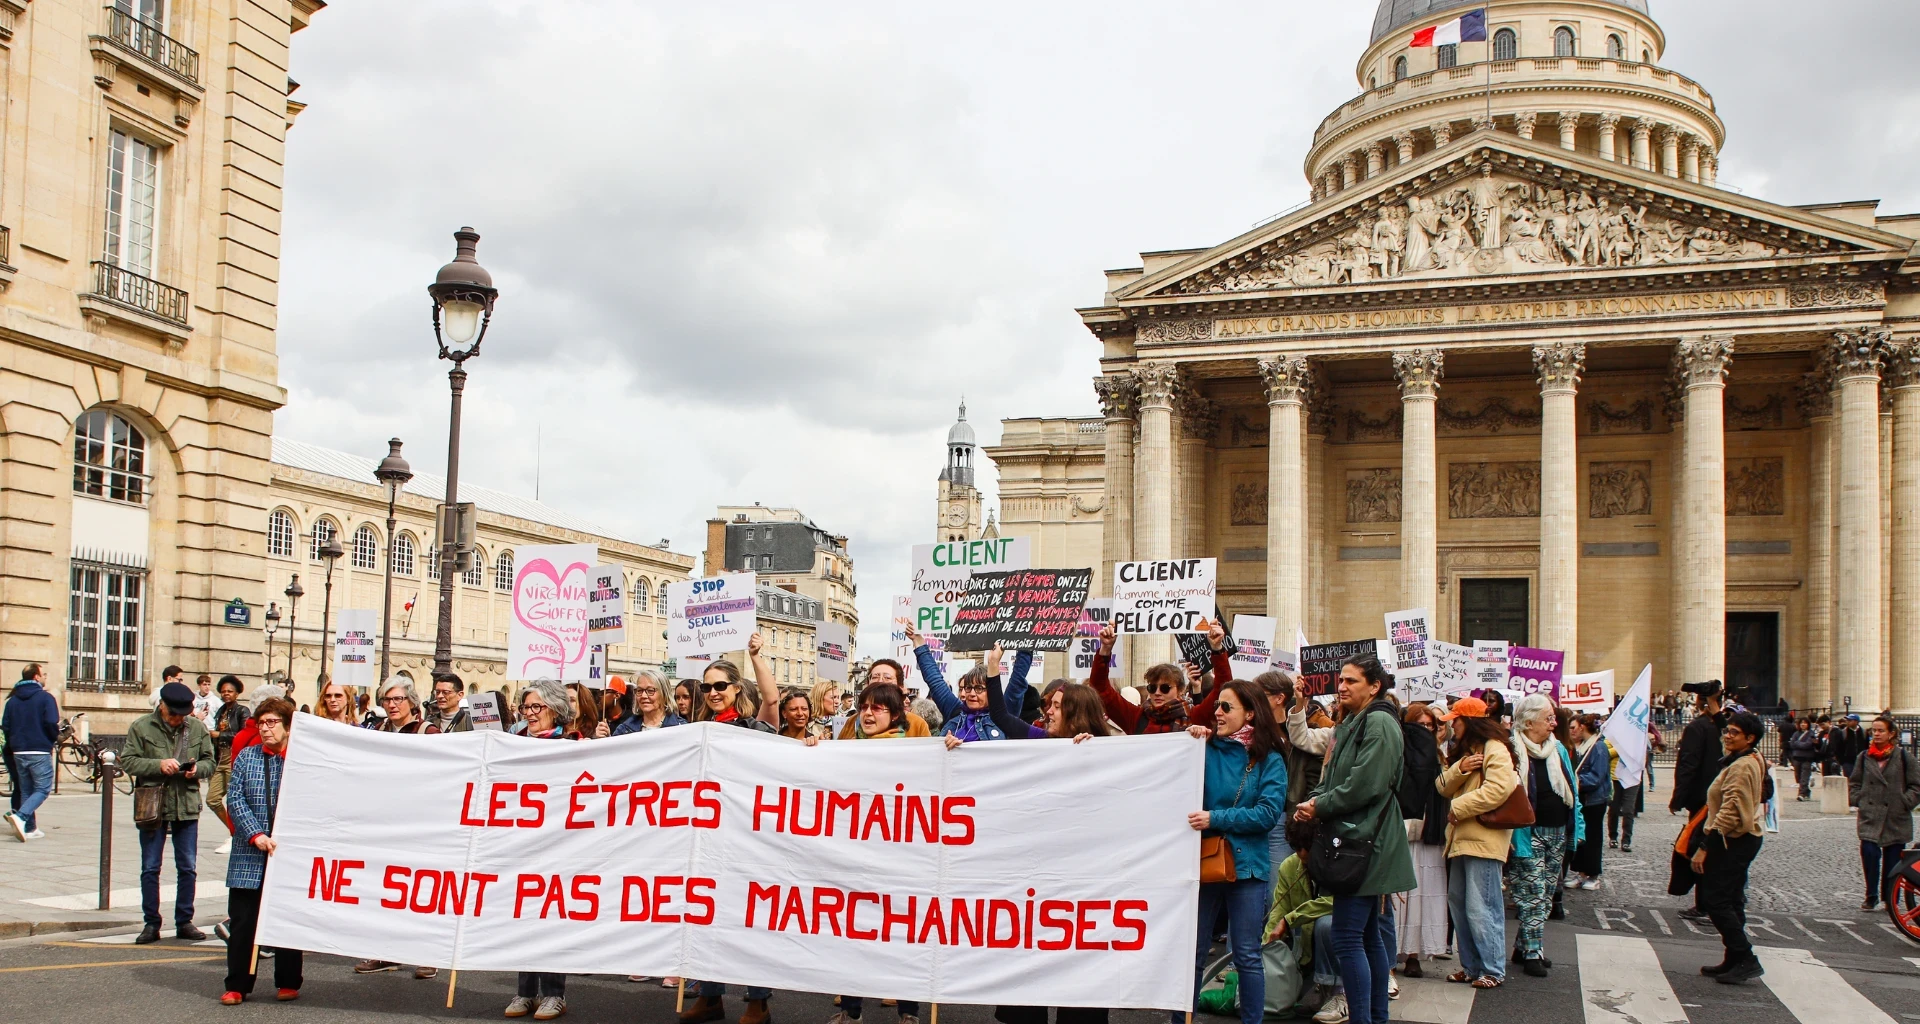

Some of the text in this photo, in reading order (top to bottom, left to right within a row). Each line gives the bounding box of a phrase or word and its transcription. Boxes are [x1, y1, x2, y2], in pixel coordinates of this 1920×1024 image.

[1219, 289, 1778, 336] AUX GRANDS HOMMES LA PATRIE RECONNAISSANTE
[933, 538, 1014, 567] CLIENT
[597, 576, 611, 589] SEX
[692, 579, 725, 594] STOP
[989, 577, 1006, 588] QUE
[1004, 575, 1019, 588] LES
[1020, 572, 1056, 588] FEMMES
[1057, 575, 1077, 587] ONT
[1076, 574, 1089, 588] LE
[525, 581, 587, 600] VIRGINIA
[590, 587, 619, 603] BUYERS
[934, 590, 968, 604] COM
[962, 592, 990, 608] DROIT
[990, 592, 1002, 606] DE
[1004, 590, 1014, 603] SE
[1062, 590, 1086, 603] C'EST
[1135, 598, 1186, 609] COMME
[957, 605, 1080, 620] MASQUER QUE LES HOMMES
[589, 615, 622, 630] RAPISTS
[688, 614, 730, 629] SEXUEL
[952, 623, 968, 635] ONT
[967, 622, 979, 634] LE
[978, 620, 1003, 634] DROIT
[1002, 621, 1014, 633] DE
[1015, 621, 1033, 633] LES
[1391, 618, 1424, 629] POUR UNE
[677, 627, 738, 647] des femmes
[1418, 633, 1428, 642] DU
[1310, 648, 1324, 660] ANS
[1349, 644, 1357, 655] LE
[1398, 649, 1425, 660] ET DE LA
[1313, 660, 1343, 673] S'ACHET
[1397, 658, 1429, 669] VIOLENCE
[1304, 673, 1330, 696] STOP
[460, 771, 976, 846] LES ÊTRES HUMAINS
[308, 856, 1149, 951] NE SONT PAS DES MARCHANDISES
